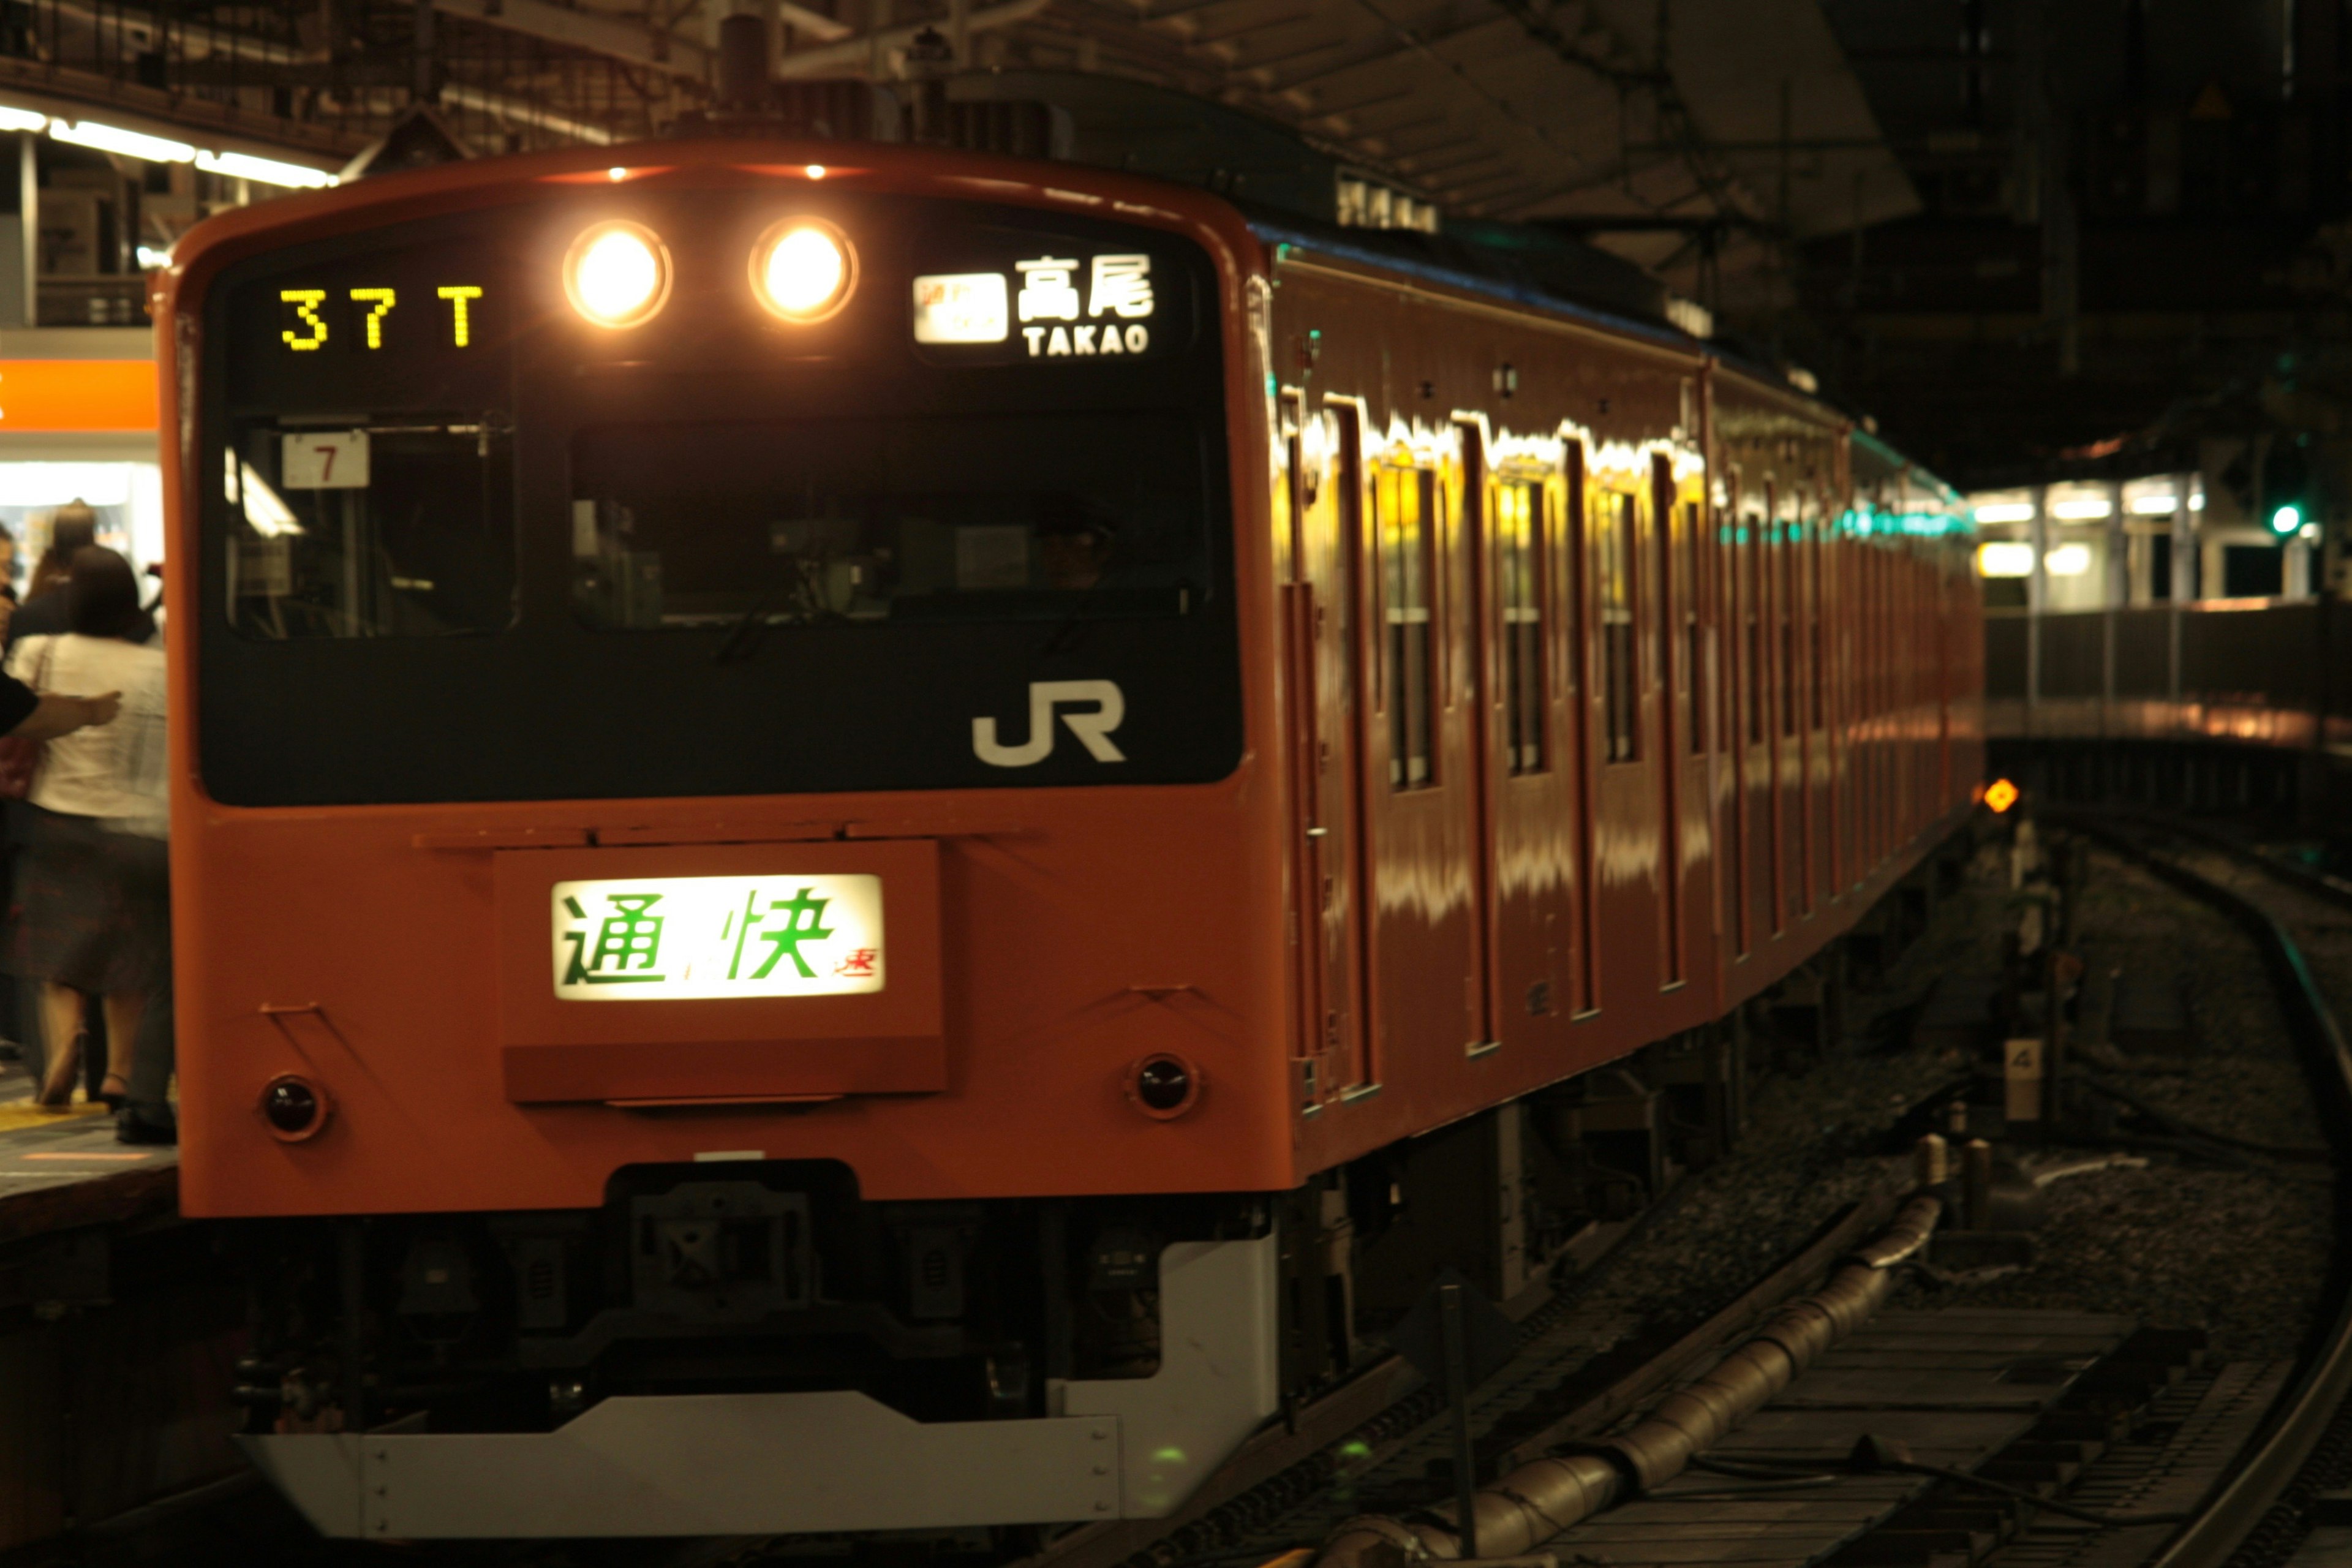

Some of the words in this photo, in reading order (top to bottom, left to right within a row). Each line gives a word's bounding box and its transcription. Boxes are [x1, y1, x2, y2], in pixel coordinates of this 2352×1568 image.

[1014, 254, 1155, 322] 高尾
[1022, 323, 1149, 357] TAKAO
[314, 446, 337, 482] 7
[971, 678, 1128, 768] JR
[2013, 1048, 2032, 1069] 4
